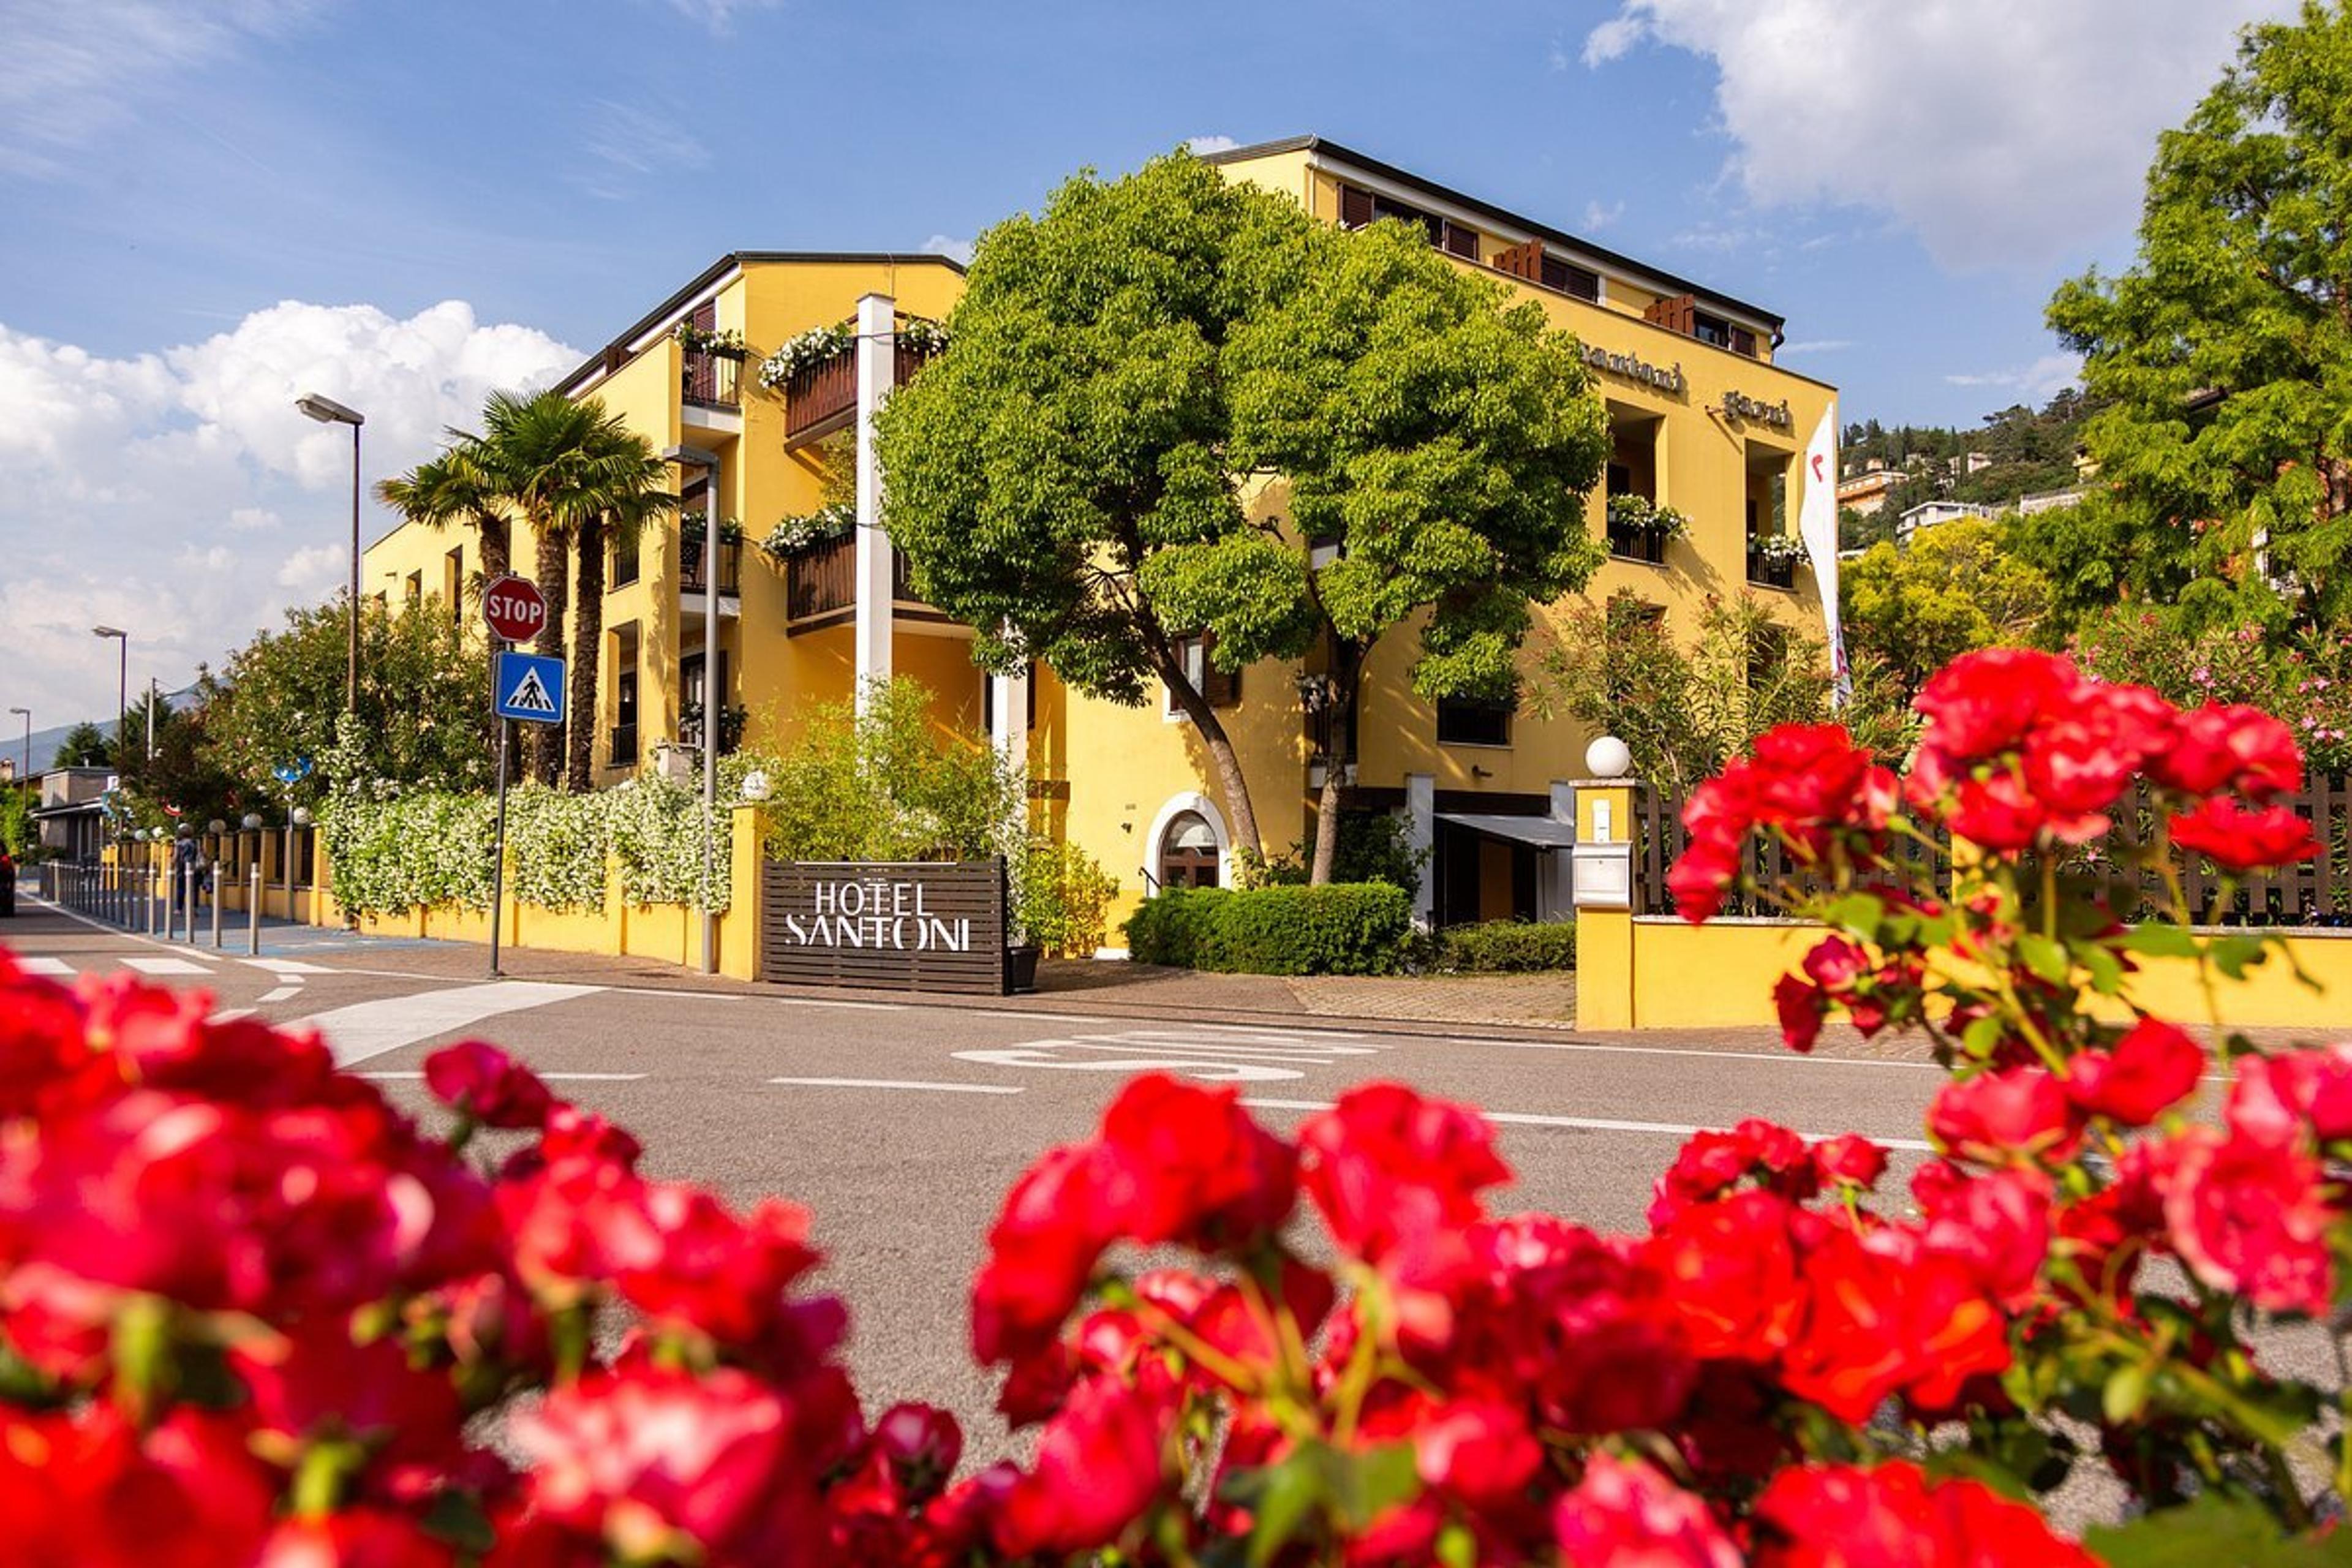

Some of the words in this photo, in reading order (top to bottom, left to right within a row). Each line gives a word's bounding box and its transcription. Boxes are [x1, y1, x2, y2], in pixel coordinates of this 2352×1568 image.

[490, 595, 541, 624] STOP
[816, 882, 933, 916] HOTEL
[785, 914, 969, 951] SANTONI
